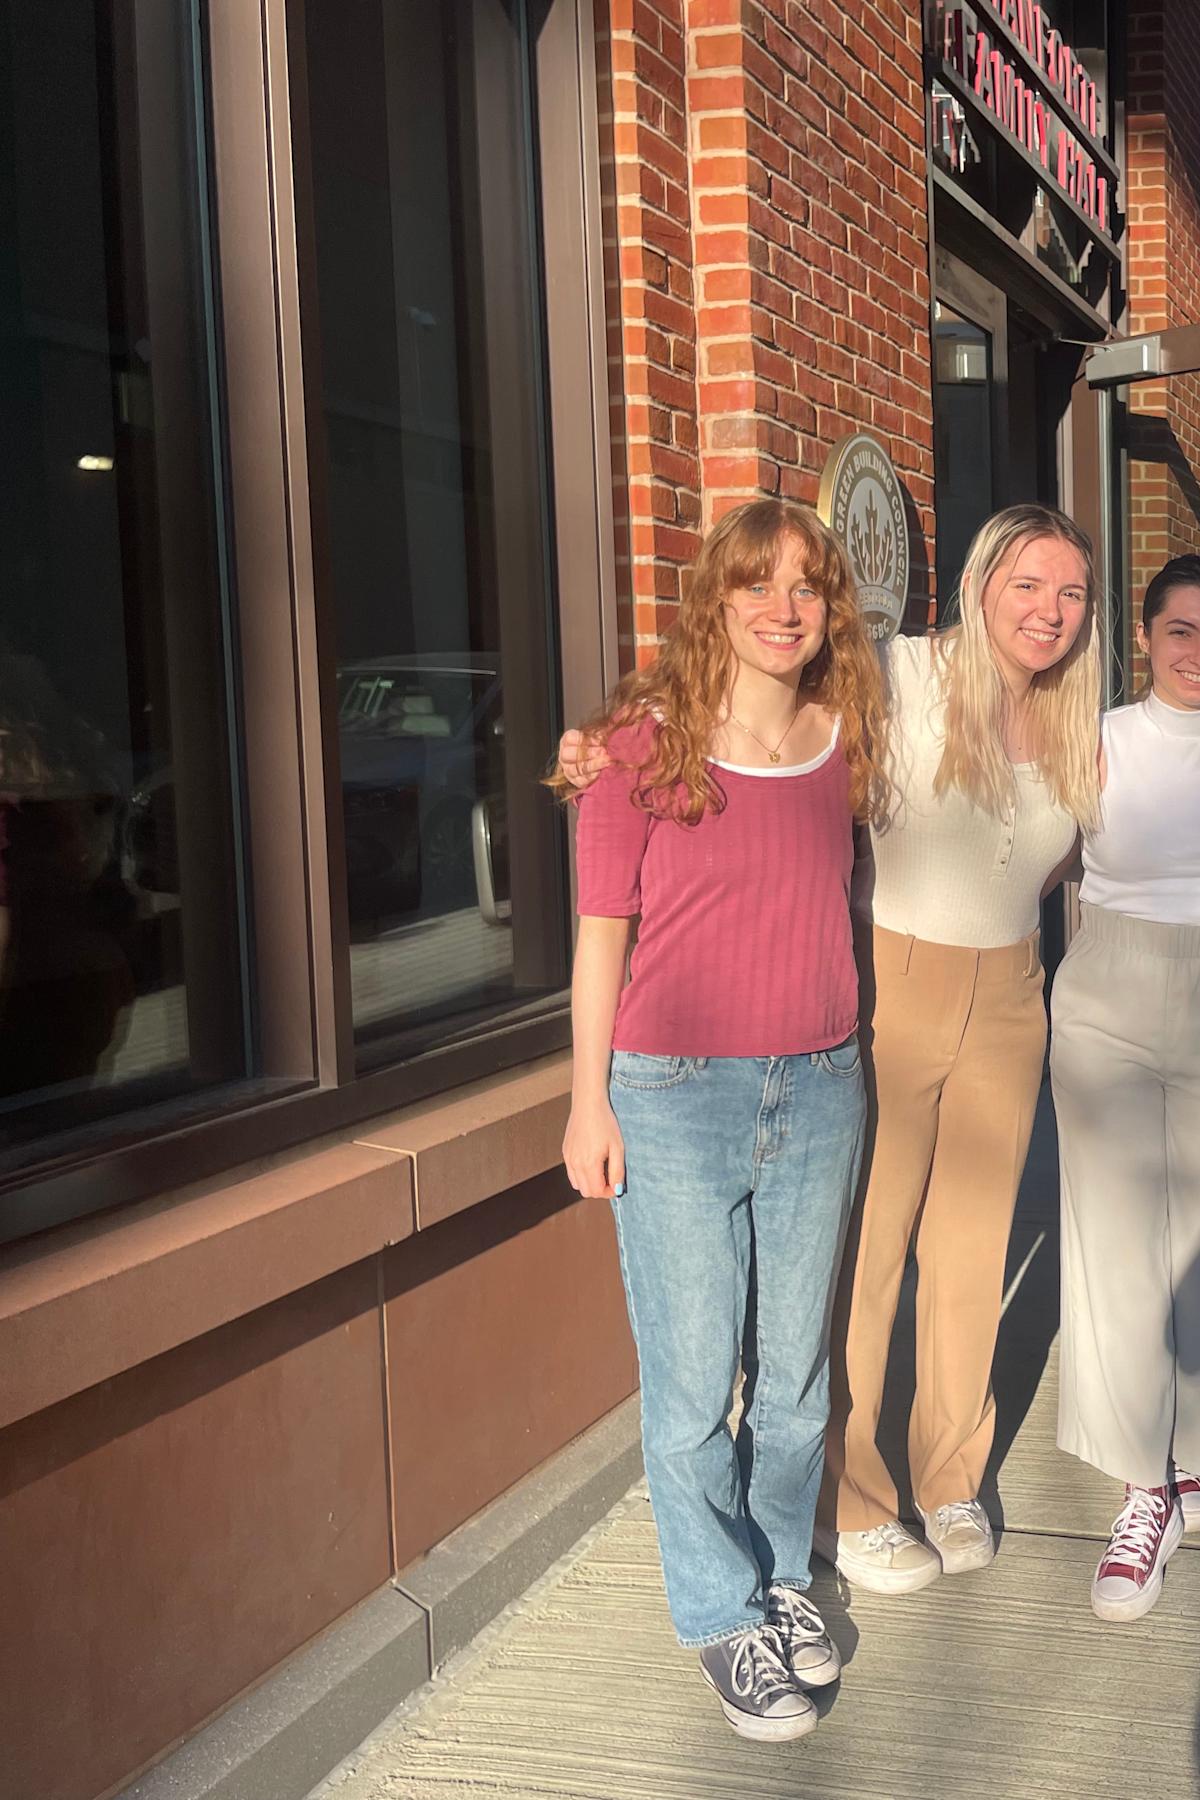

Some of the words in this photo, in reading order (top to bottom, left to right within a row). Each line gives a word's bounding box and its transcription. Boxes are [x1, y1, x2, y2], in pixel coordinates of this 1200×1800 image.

[953, 8, 1053, 169] FAMILY
[836, 463, 855, 534] GREEN
[853, 450, 893, 493] BUILDING
[891, 495, 906, 586] COUNCIL
